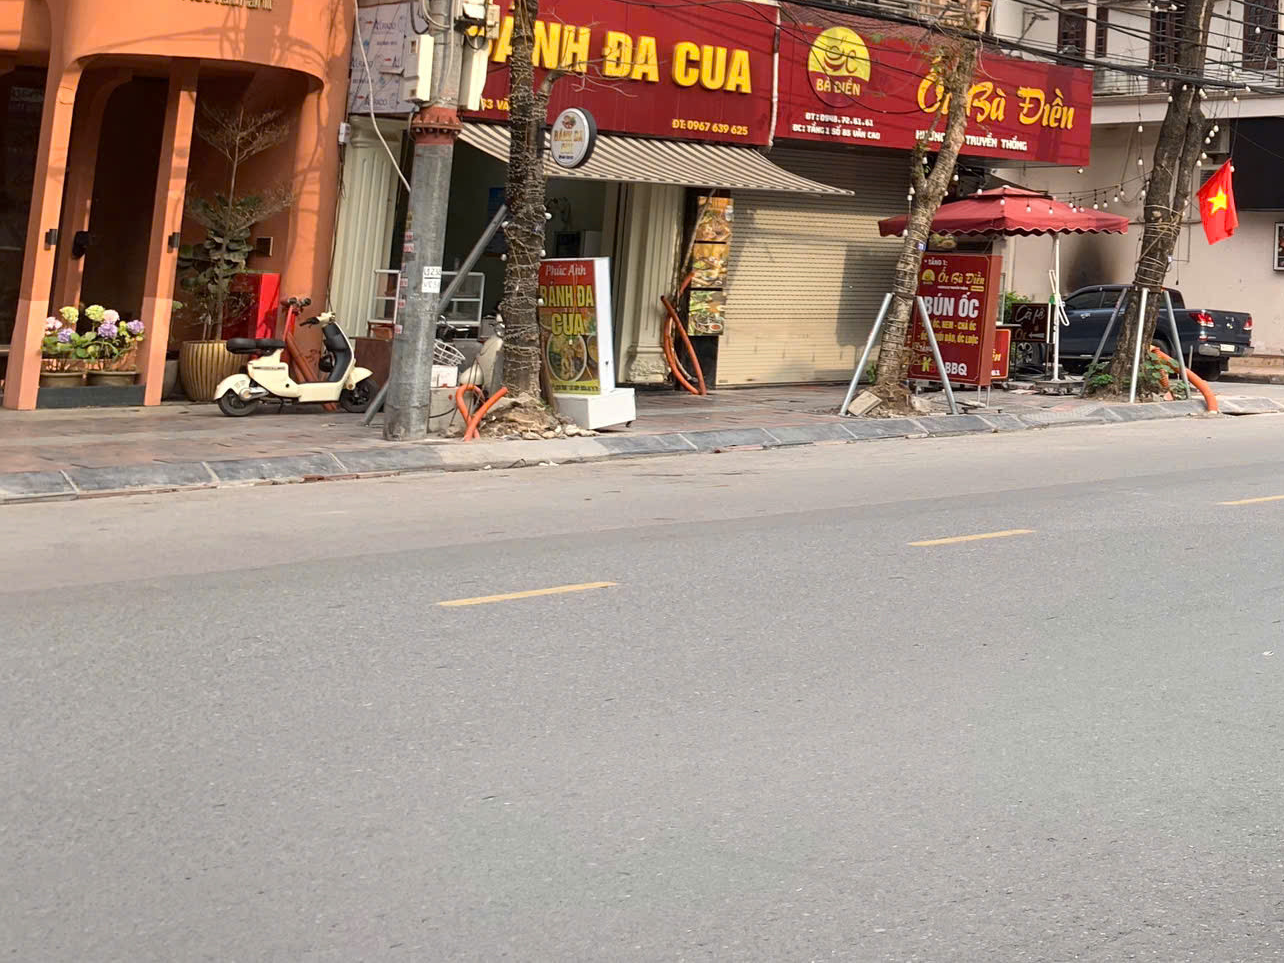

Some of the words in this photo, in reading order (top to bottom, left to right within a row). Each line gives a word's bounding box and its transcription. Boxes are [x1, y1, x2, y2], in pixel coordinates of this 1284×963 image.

[466, 0, 591, 73] ÁNH
[603, 29, 660, 83] ĐA
[672, 40, 753, 94] CUA
[1016, 86, 1075, 130] Điền
[687, 119, 711, 132] 0967
[712, 122, 730, 134] 639
[730, 124, 749, 136] 625
[1000, 135, 1028, 152] THỐNG
[540, 280, 574, 307] BÁNH
[576, 285, 594, 308] ĐA
[923, 293, 955, 317] BÚN
[958, 292, 980, 318] ỐC
[551, 313, 586, 336] CUA
[945, 361, 967, 376] BBQ
